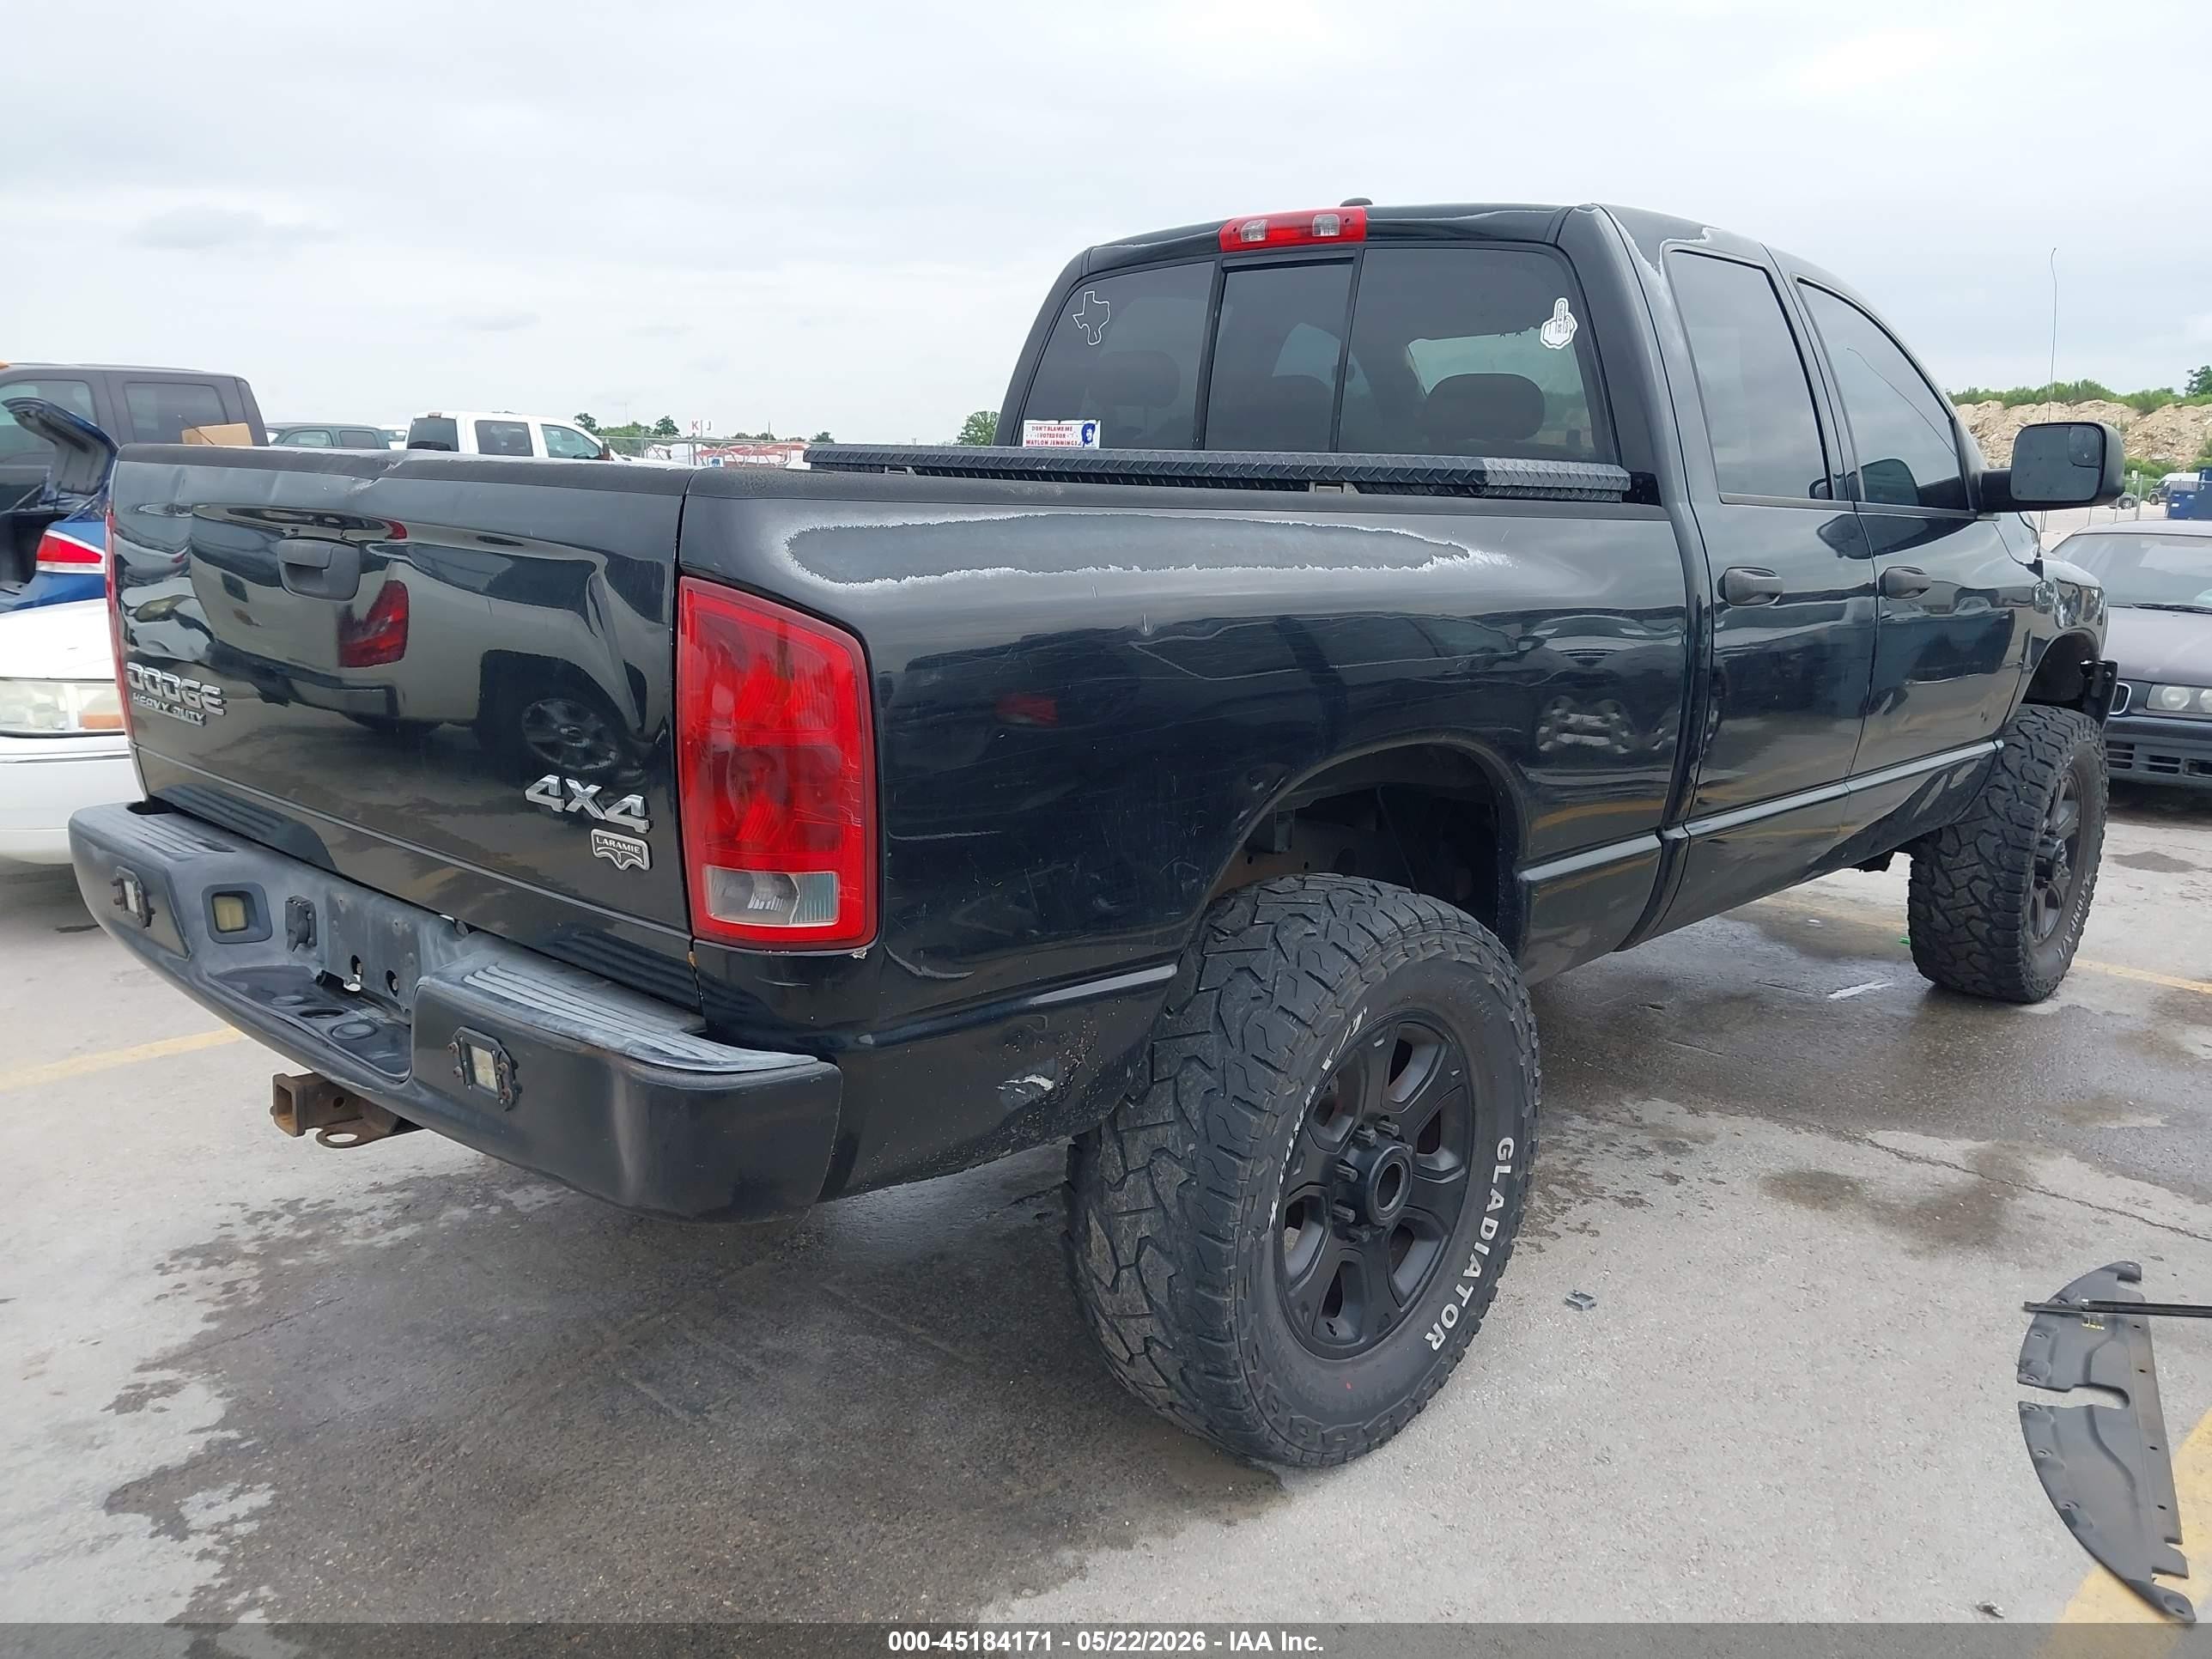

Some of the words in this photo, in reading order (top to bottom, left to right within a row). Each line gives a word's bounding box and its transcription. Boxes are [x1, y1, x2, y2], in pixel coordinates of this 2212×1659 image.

[126, 661, 225, 716] DODGE
[132, 692, 170, 712] HEAVY
[173, 706, 207, 723] DUTY
[525, 774, 650, 834] 4X4
[596, 836, 641, 854] LARAMIE
[1424, 1137, 1515, 1352] GLADIATOR
